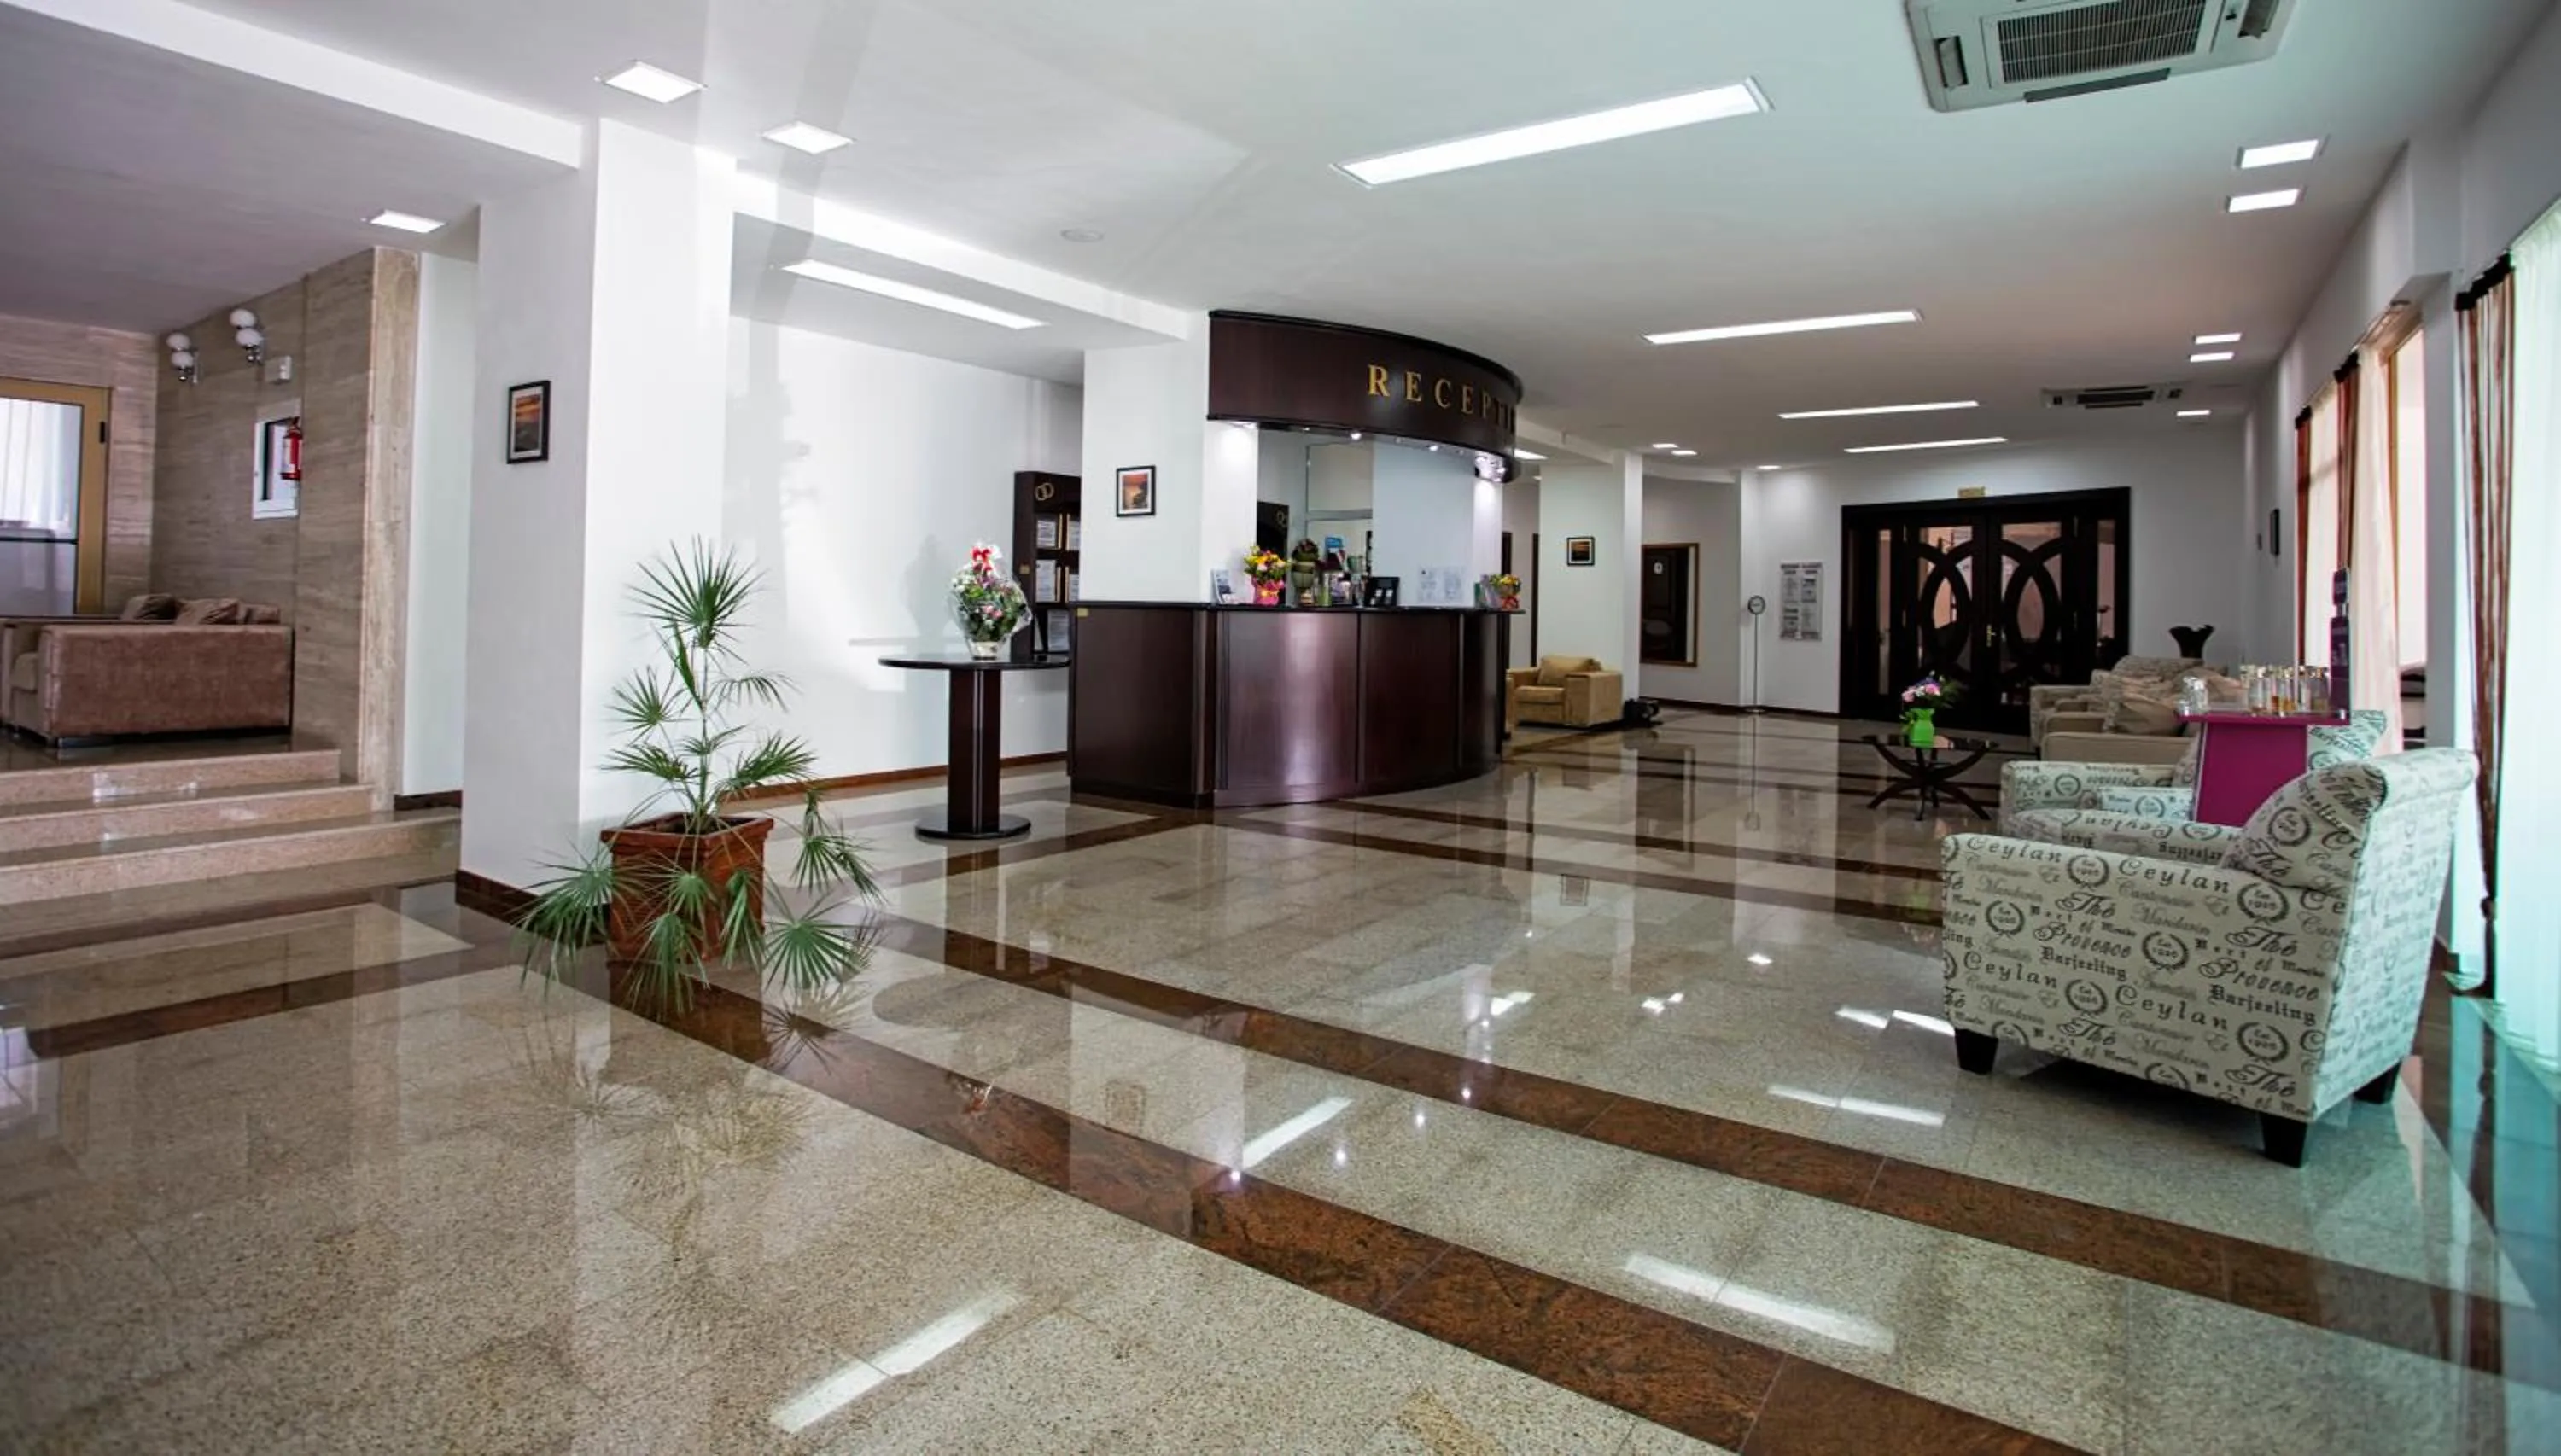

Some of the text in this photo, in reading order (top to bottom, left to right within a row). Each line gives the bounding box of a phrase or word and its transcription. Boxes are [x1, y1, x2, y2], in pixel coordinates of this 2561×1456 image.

[1967, 836, 2062, 863] Ceylan
[2119, 856, 2230, 894] Ceylan
[1964, 950, 2058, 989] Ceylan
[2115, 984, 2229, 1031] Ceylan
[2207, 983, 2316, 1027] Darjeeling
